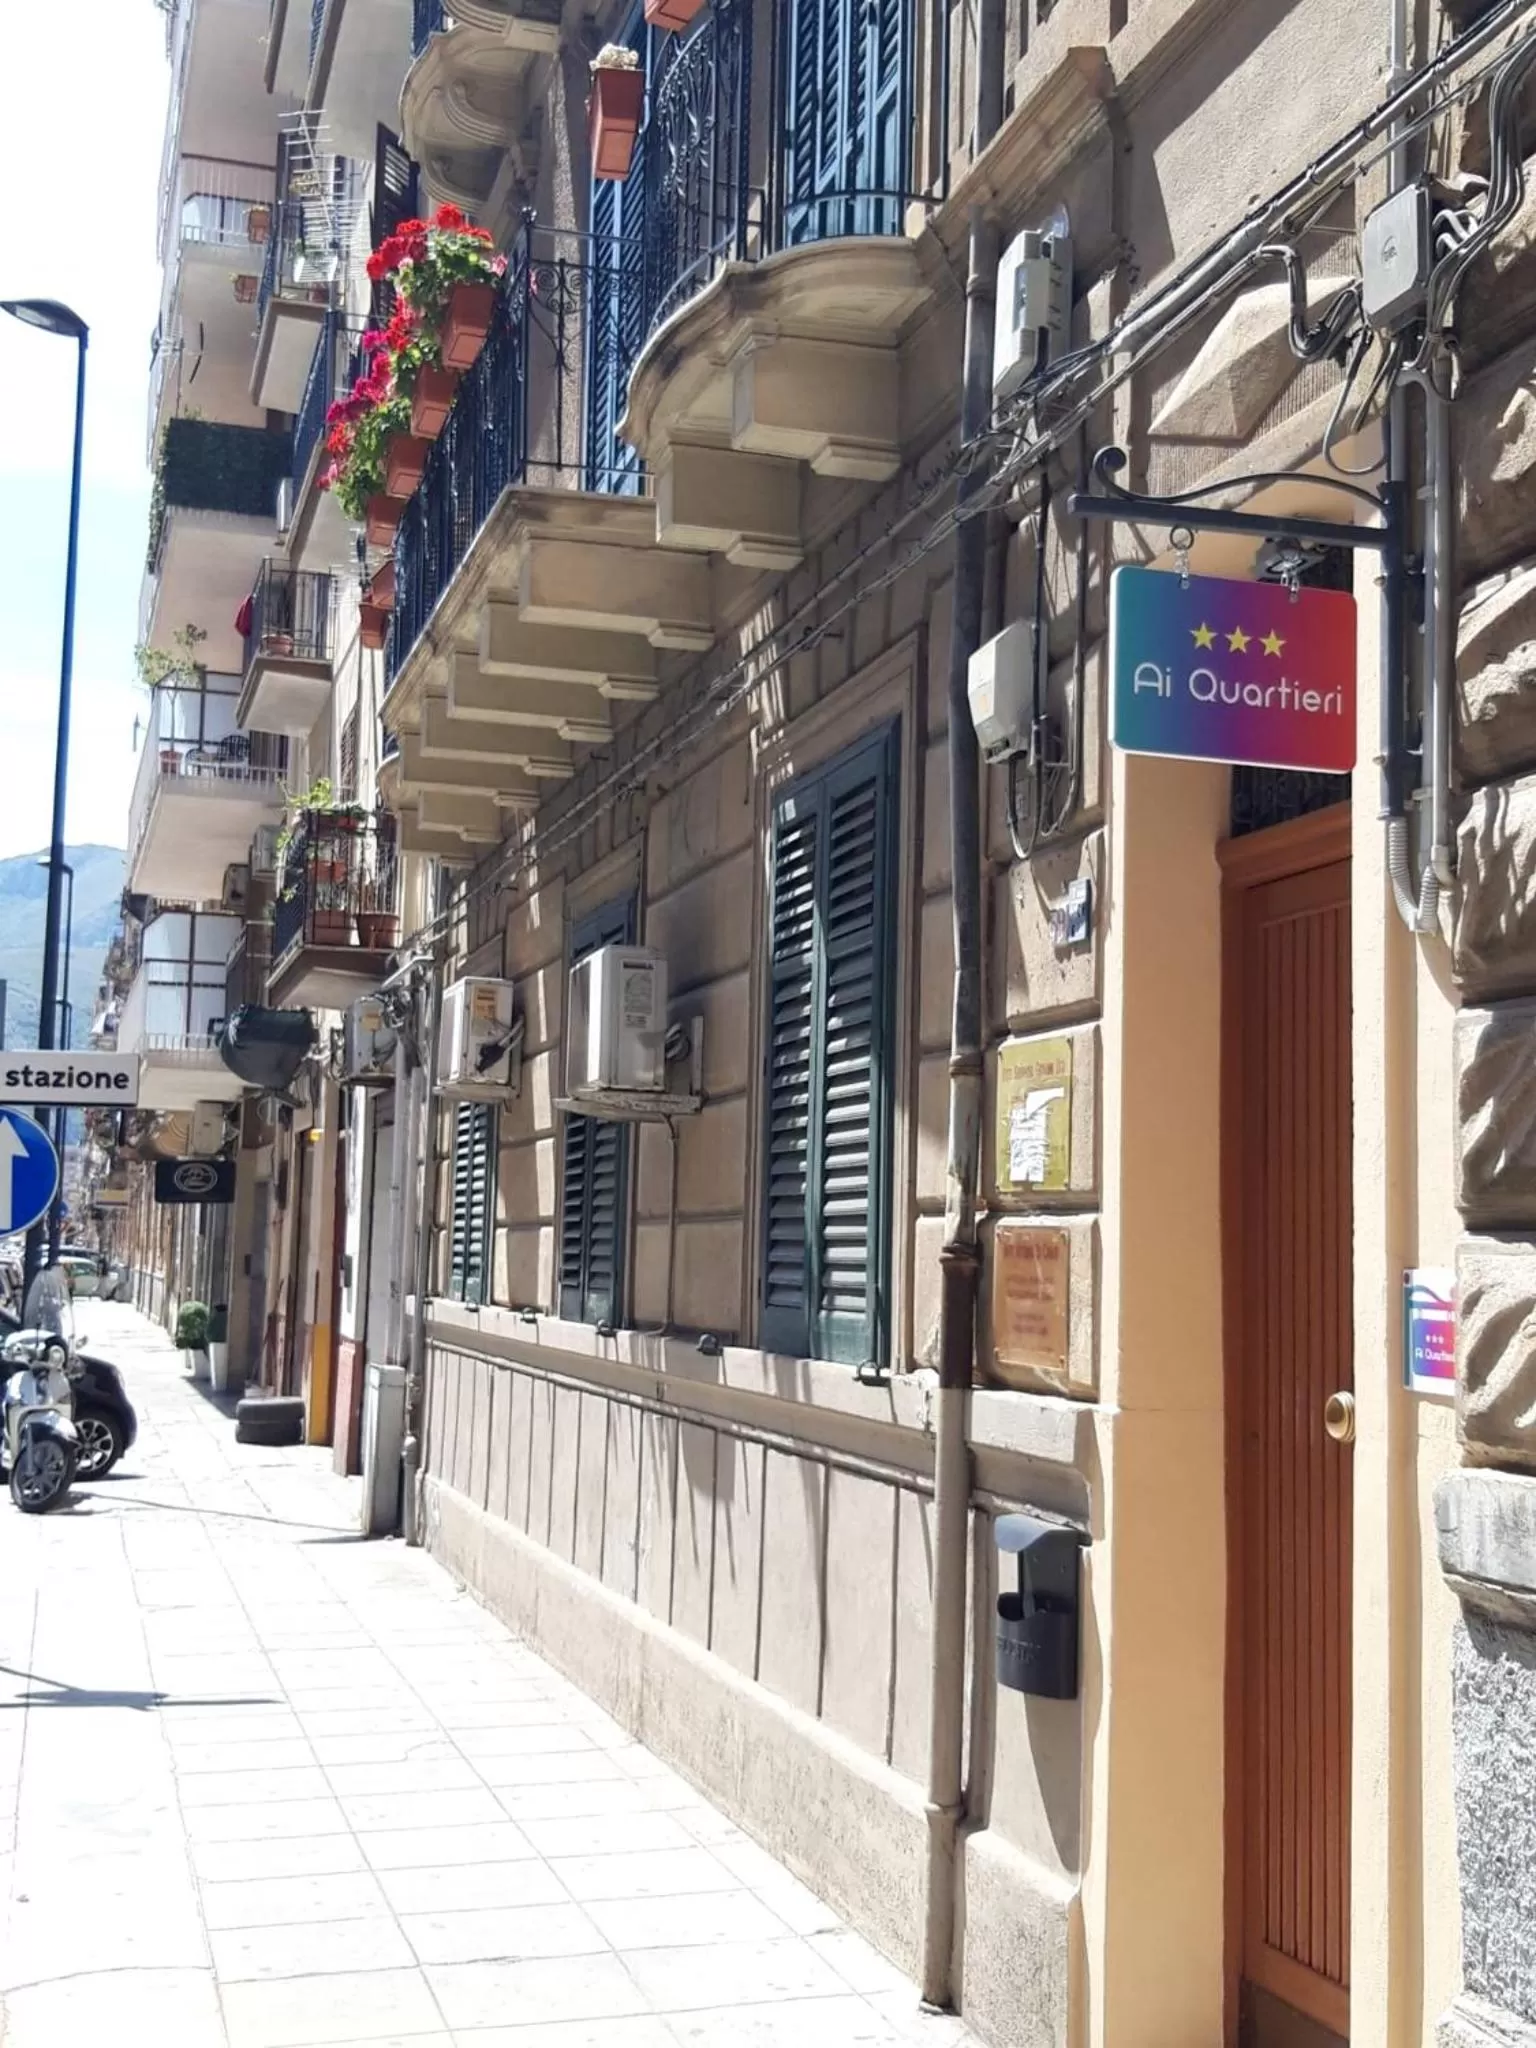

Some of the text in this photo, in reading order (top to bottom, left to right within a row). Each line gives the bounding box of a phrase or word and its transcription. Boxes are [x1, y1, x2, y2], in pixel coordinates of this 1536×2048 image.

[1133, 662, 1343, 716] Ai Quartieri
[5, 1065, 130, 1090] stazione
